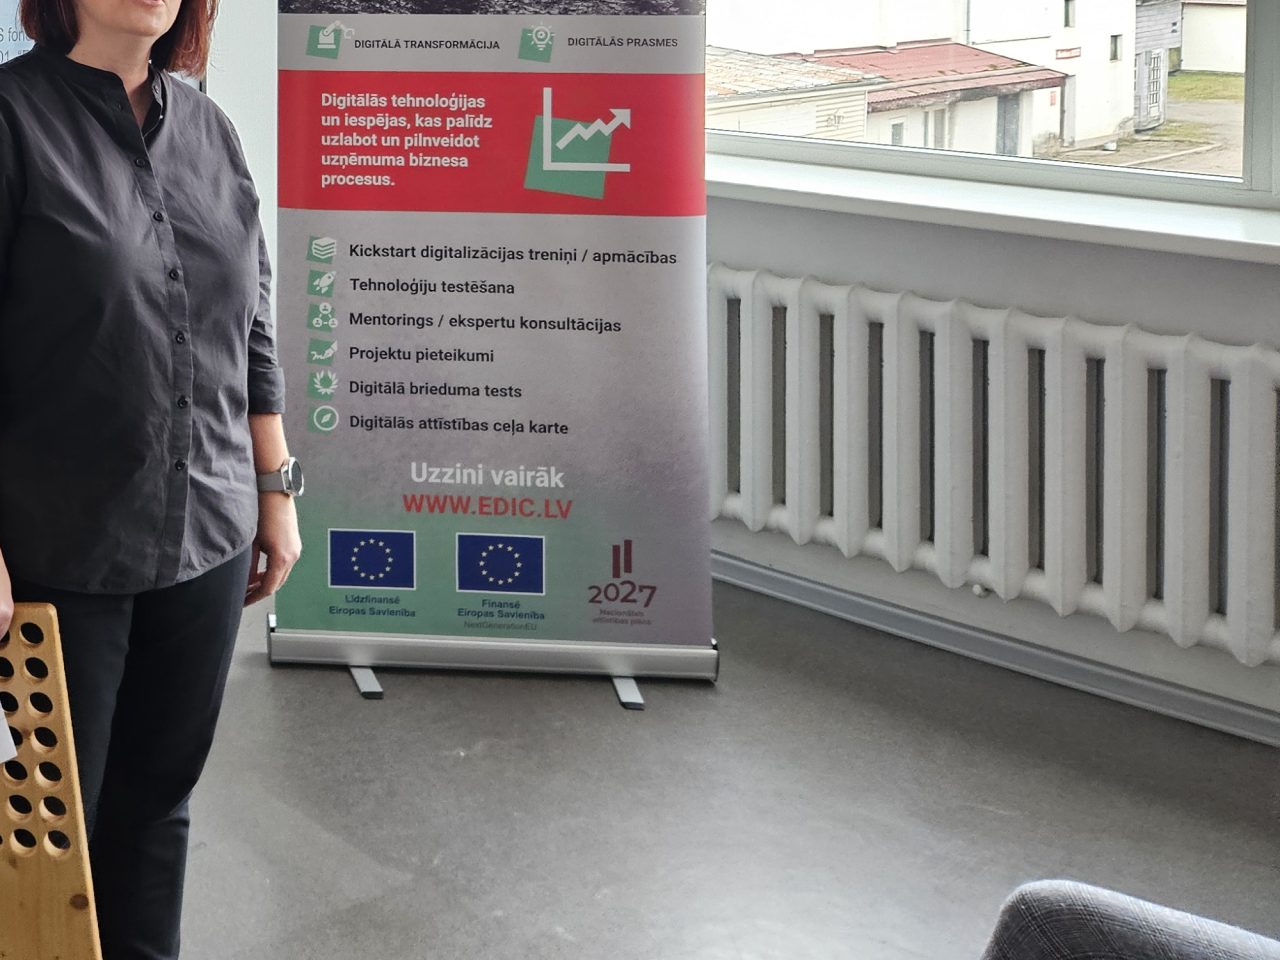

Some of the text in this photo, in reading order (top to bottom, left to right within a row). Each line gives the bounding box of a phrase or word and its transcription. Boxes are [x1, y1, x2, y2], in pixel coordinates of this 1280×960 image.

[354, 37, 500, 50] DIGITĀLĀ TRANSFORMĀCIJA
[567, 36, 678, 48] DIGITĀLĀS PRASMES
[321, 93, 486, 112] Digitālās tehnoloģijas
[321, 113, 493, 132] un iespējas, kas palīdz
[321, 132, 480, 150] uzlabot un pilnveidot
[321, 152, 468, 170] uzņēmuma biznesa
[321, 174, 395, 189] procesus.
[349, 244, 416, 259] Kickstart
[420, 245, 524, 262] digitalizācijas
[528, 247, 578, 265] treniņi
[592, 249, 677, 267] apmācības
[350, 278, 515, 296] Tehnoloģiju testēšana
[349, 313, 434, 330] Mentorings
[449, 315, 515, 331] ekspertu
[520, 316, 621, 334] konsultācijas
[349, 346, 494, 366] Projektu pieteikumi
[349, 381, 523, 398] Digitālā brieduma tests
[349, 415, 569, 437] Digitālās attīstības ceļa karte
[410, 461, 565, 489] Uzzini vairāk
[402, 494, 573, 520] WWW.EDIC.LV
[588, 580, 657, 608] 2027
[329, 606, 366, 617] Eiropas
[457, 608, 495, 619] Eiropas
